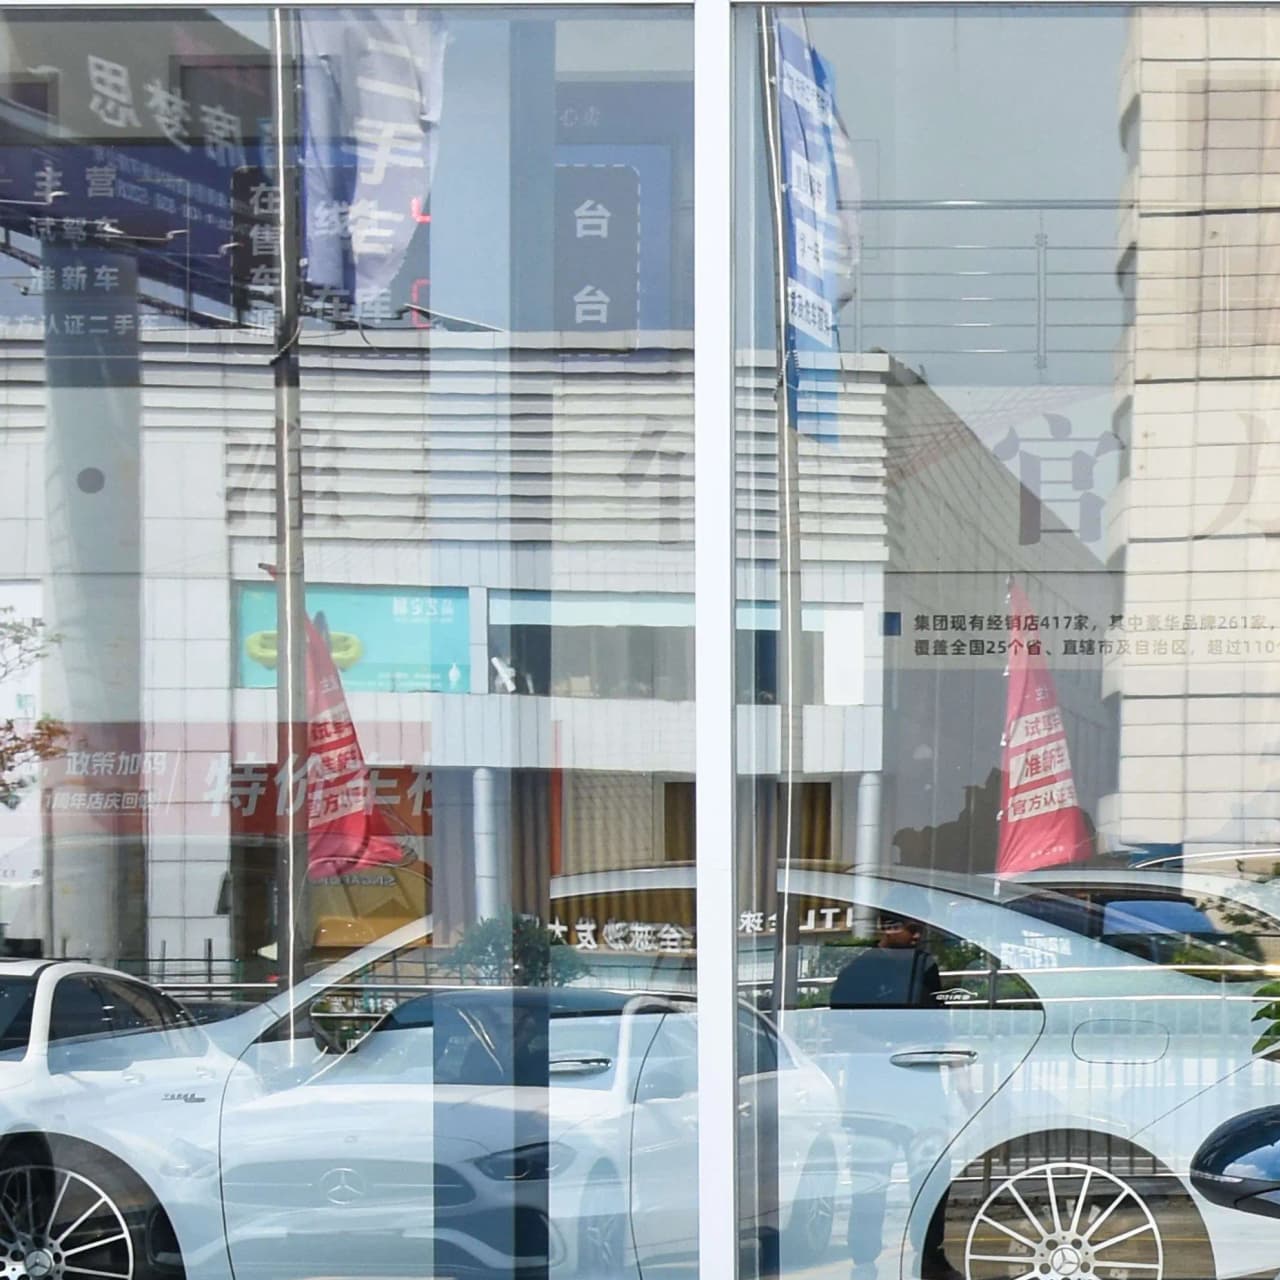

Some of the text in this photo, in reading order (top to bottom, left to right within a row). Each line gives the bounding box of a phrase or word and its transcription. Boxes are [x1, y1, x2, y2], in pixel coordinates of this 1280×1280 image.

[574, 199, 611, 239] 台
[31, 265, 119, 292] 准新车
[573, 284, 610, 324] 台
